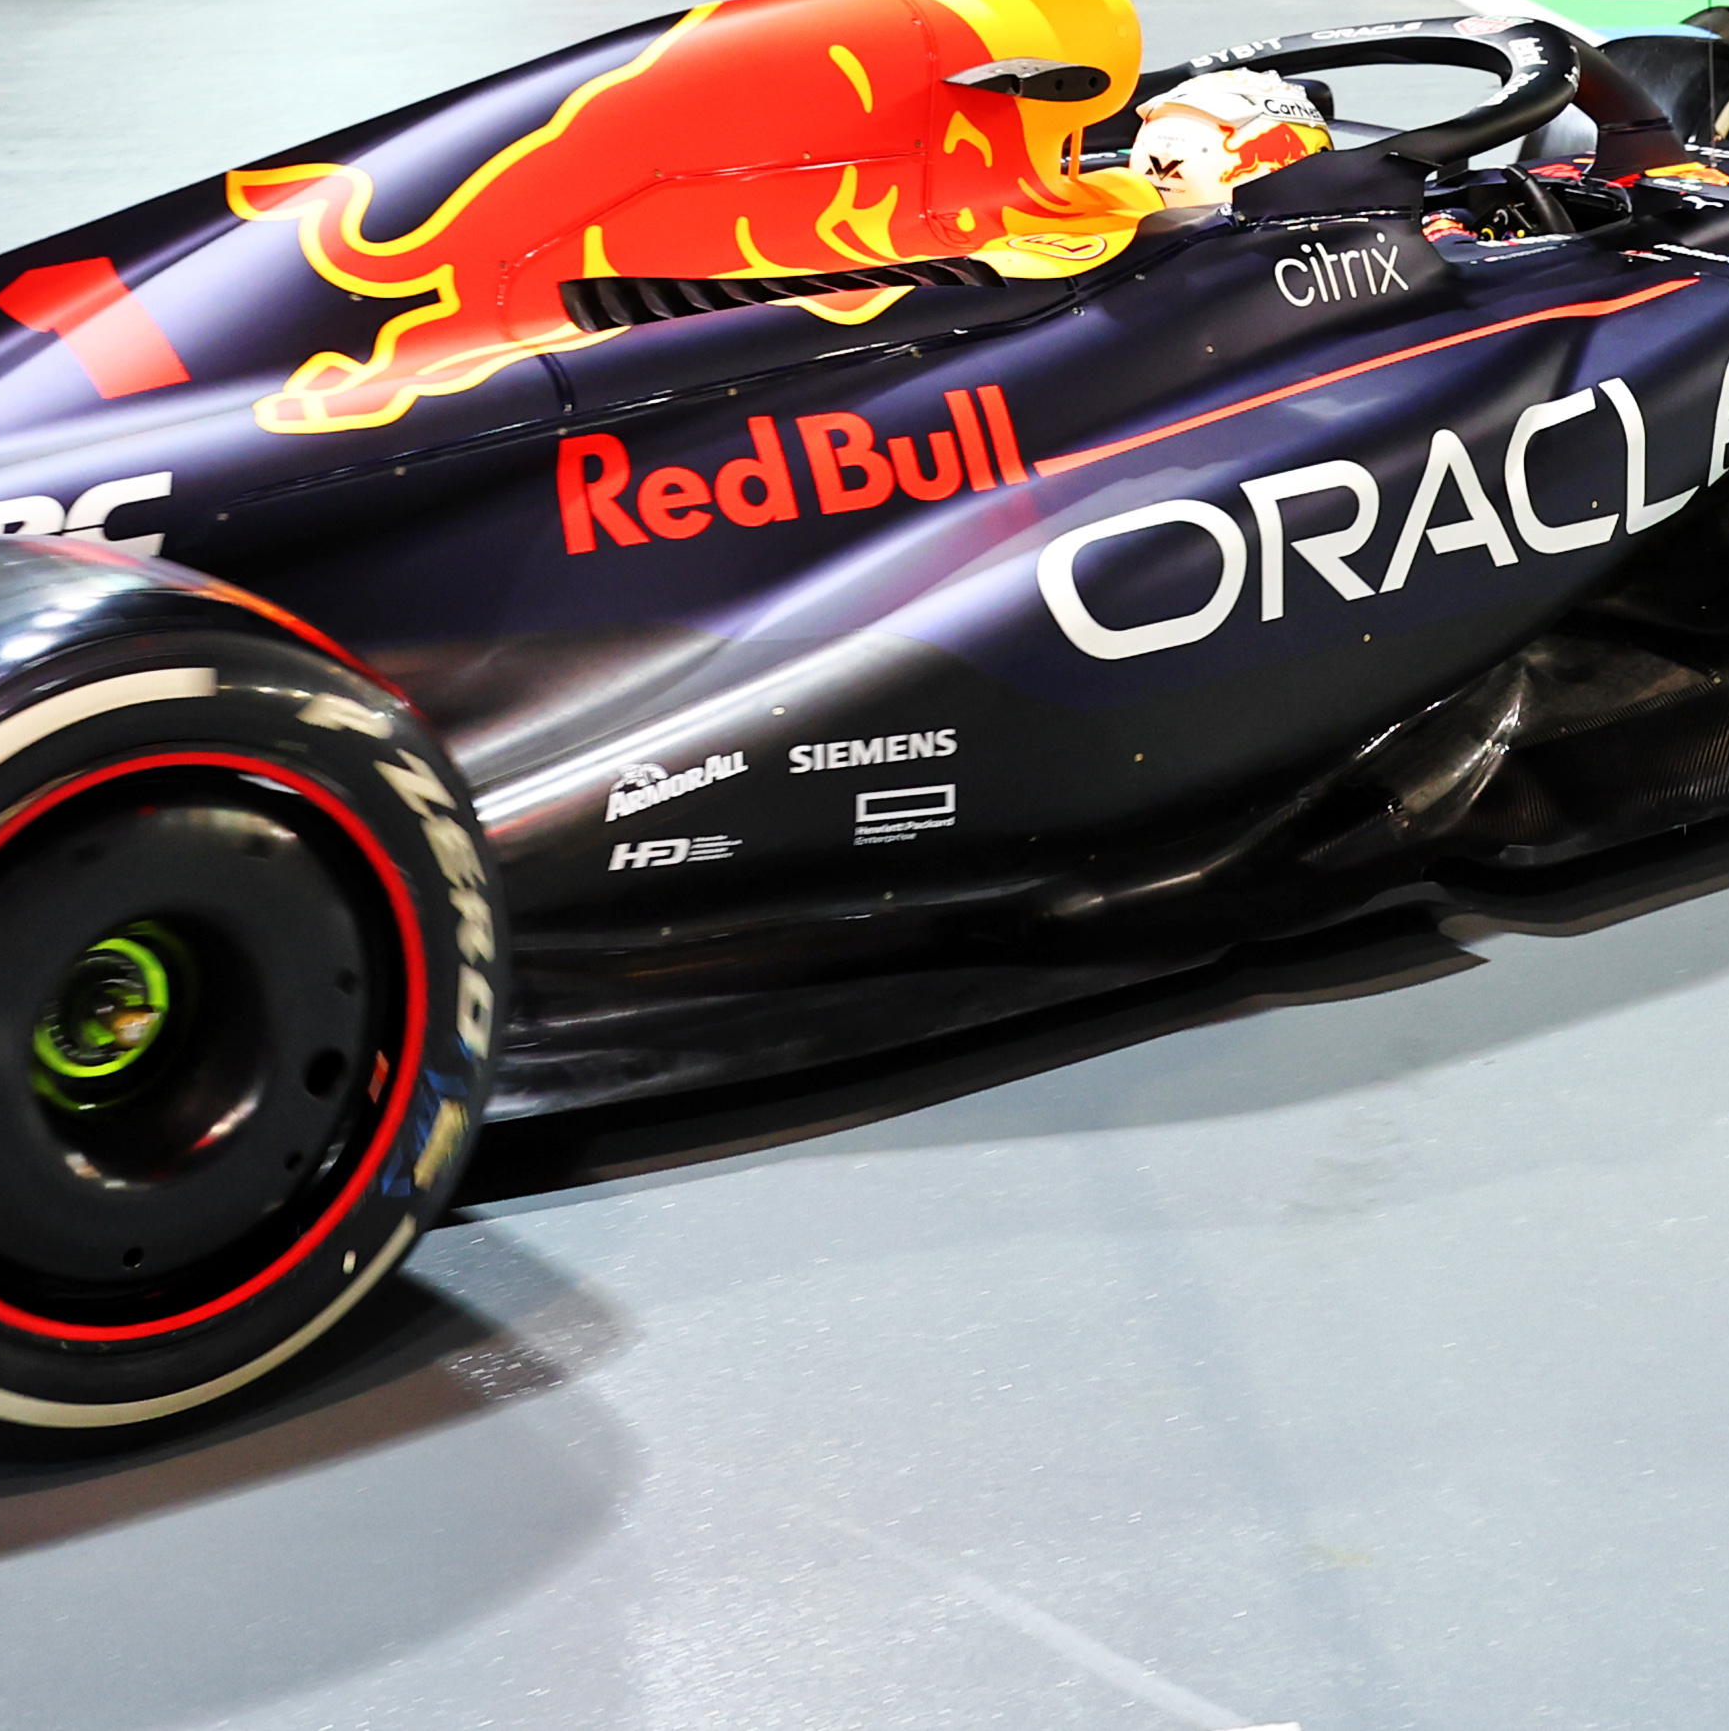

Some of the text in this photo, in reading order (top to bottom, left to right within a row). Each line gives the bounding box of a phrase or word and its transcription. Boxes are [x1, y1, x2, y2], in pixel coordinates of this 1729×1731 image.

[1189, 36, 1283, 68] BYBIT
[1311, 22, 1423, 41] ORACLE
[1274, 233, 1409, 308] citrix
[556, 385, 1030, 555] Red Bull
[788, 729, 958, 774] SIEMENS
